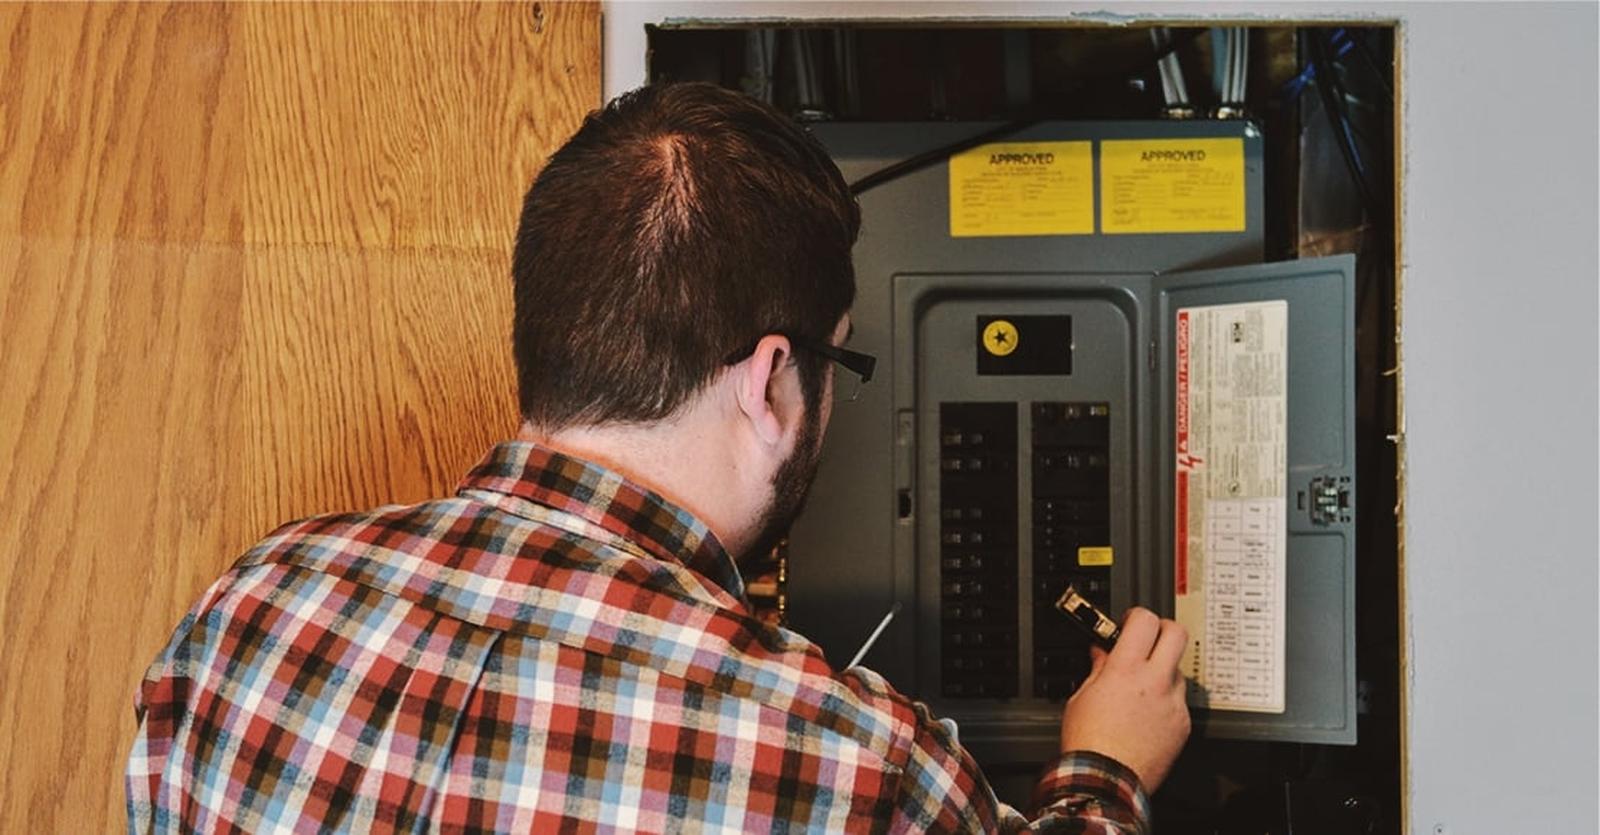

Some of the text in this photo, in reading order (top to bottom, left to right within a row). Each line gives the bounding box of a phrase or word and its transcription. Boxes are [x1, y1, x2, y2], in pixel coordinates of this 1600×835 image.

[989, 152, 1055, 164] APPROVED
[1141, 150, 1206, 162] APPROVED
[1179, 319, 1188, 372] PELIGRO
[1179, 382, 1188, 433] DANGER
